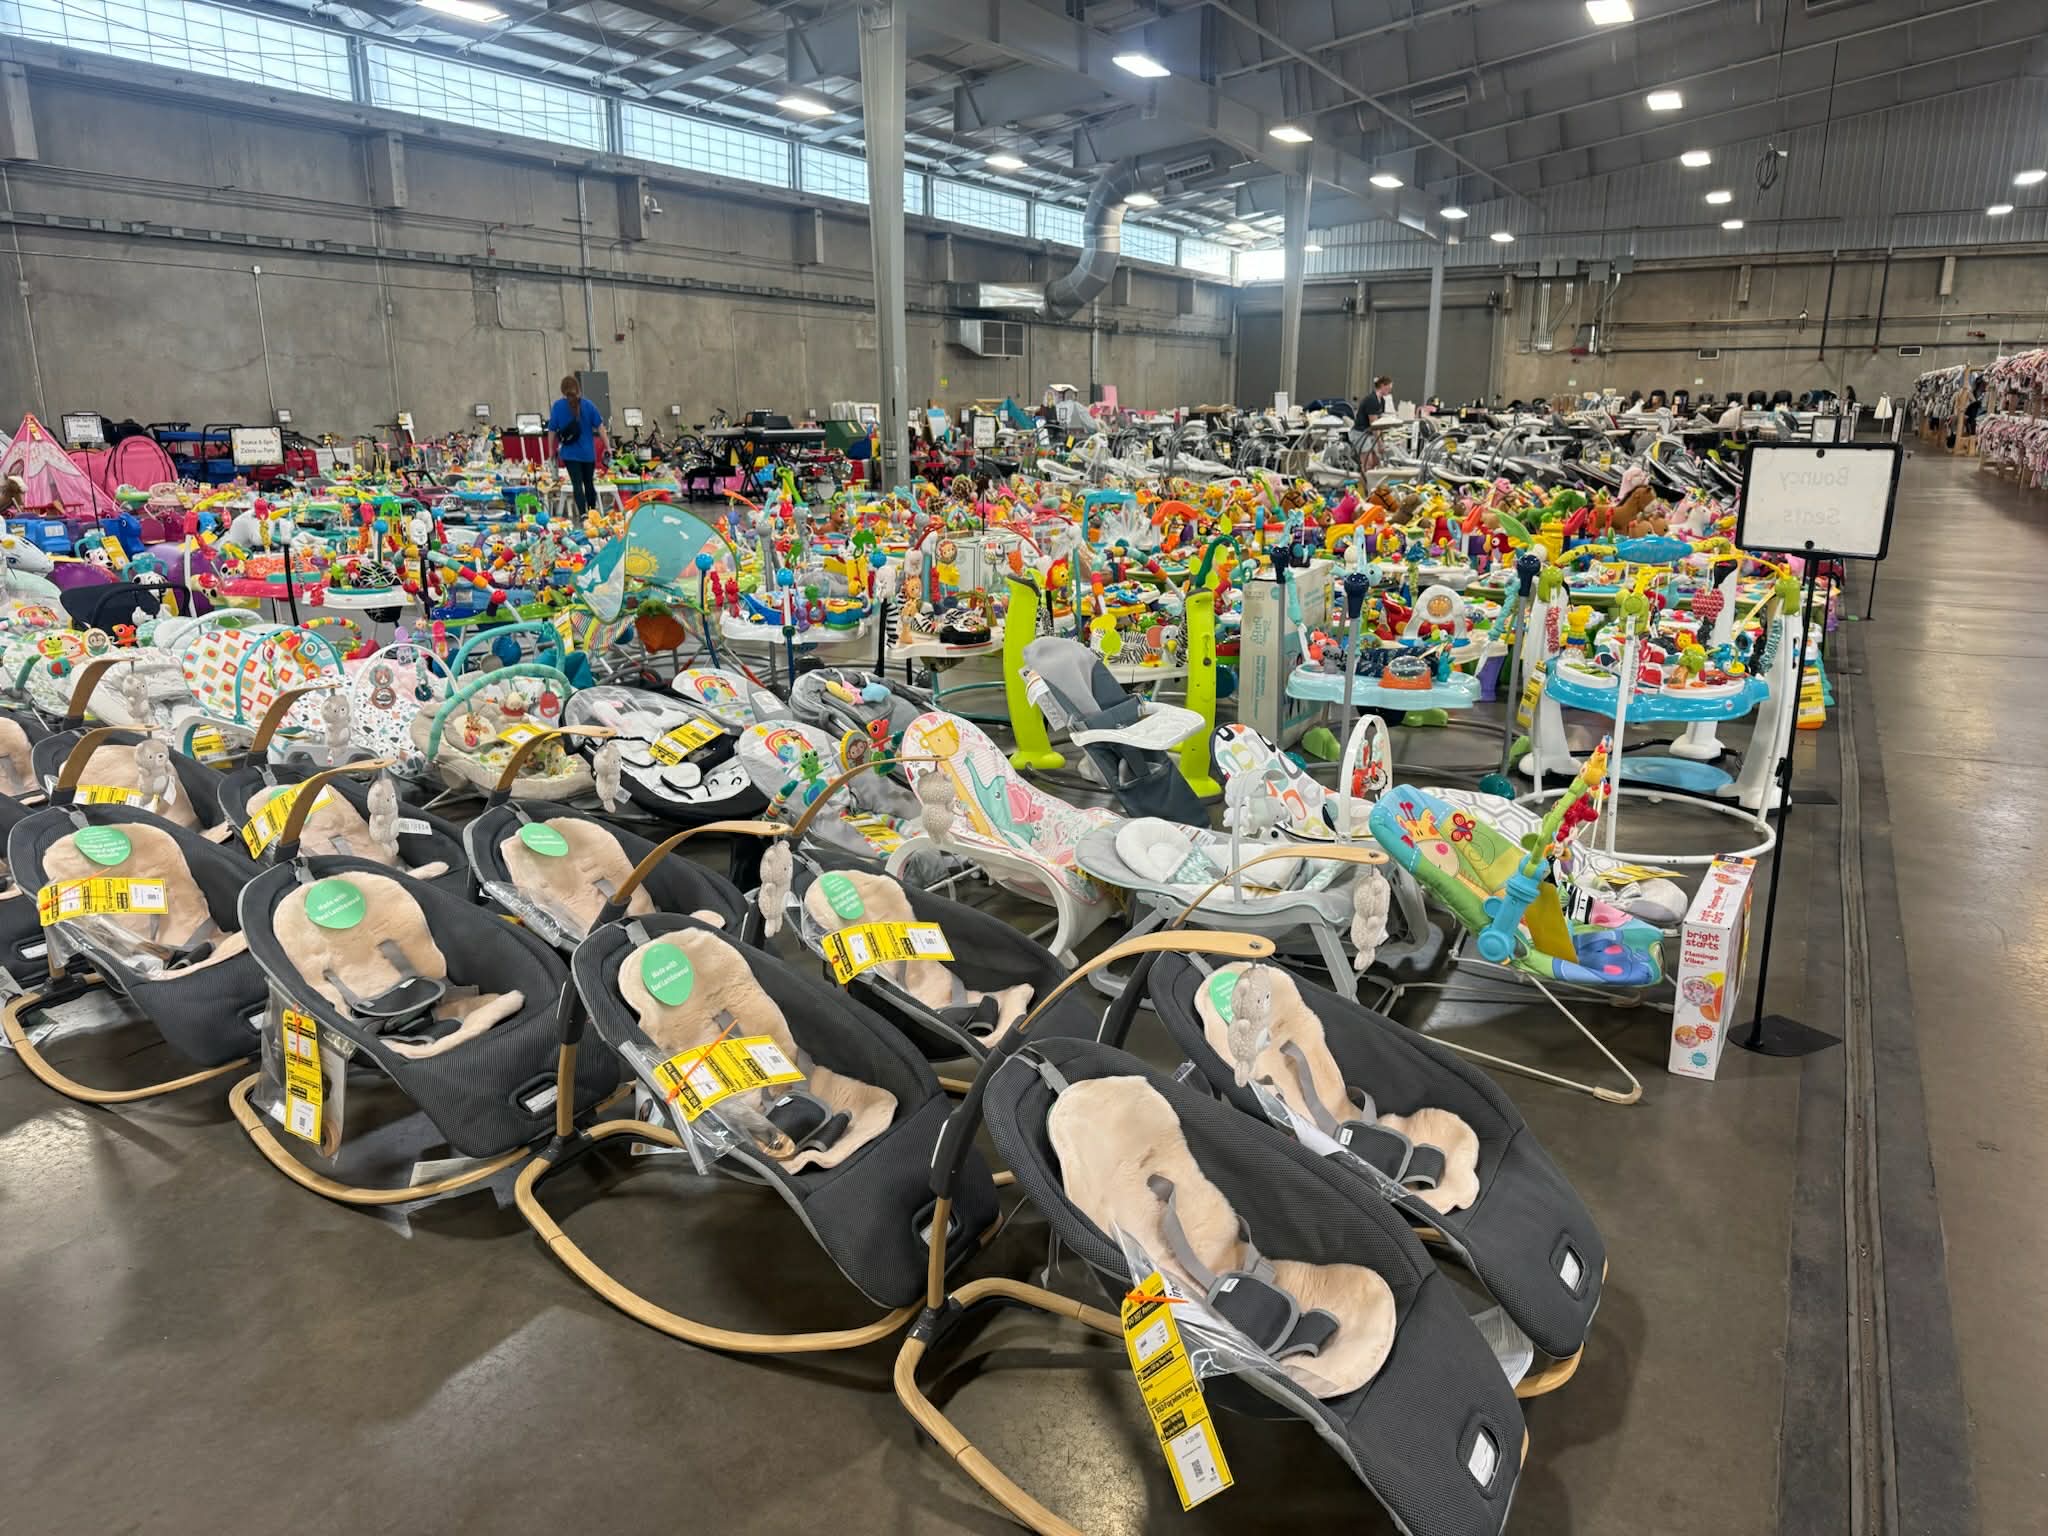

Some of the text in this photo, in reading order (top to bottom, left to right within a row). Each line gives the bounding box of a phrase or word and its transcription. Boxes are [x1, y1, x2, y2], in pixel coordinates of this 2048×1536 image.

[1687, 930, 1719, 942] bright
[1685, 939, 1719, 950] starts
[1684, 950, 1719, 961] Flamingo
[1684, 957, 1704, 965] Vibes
